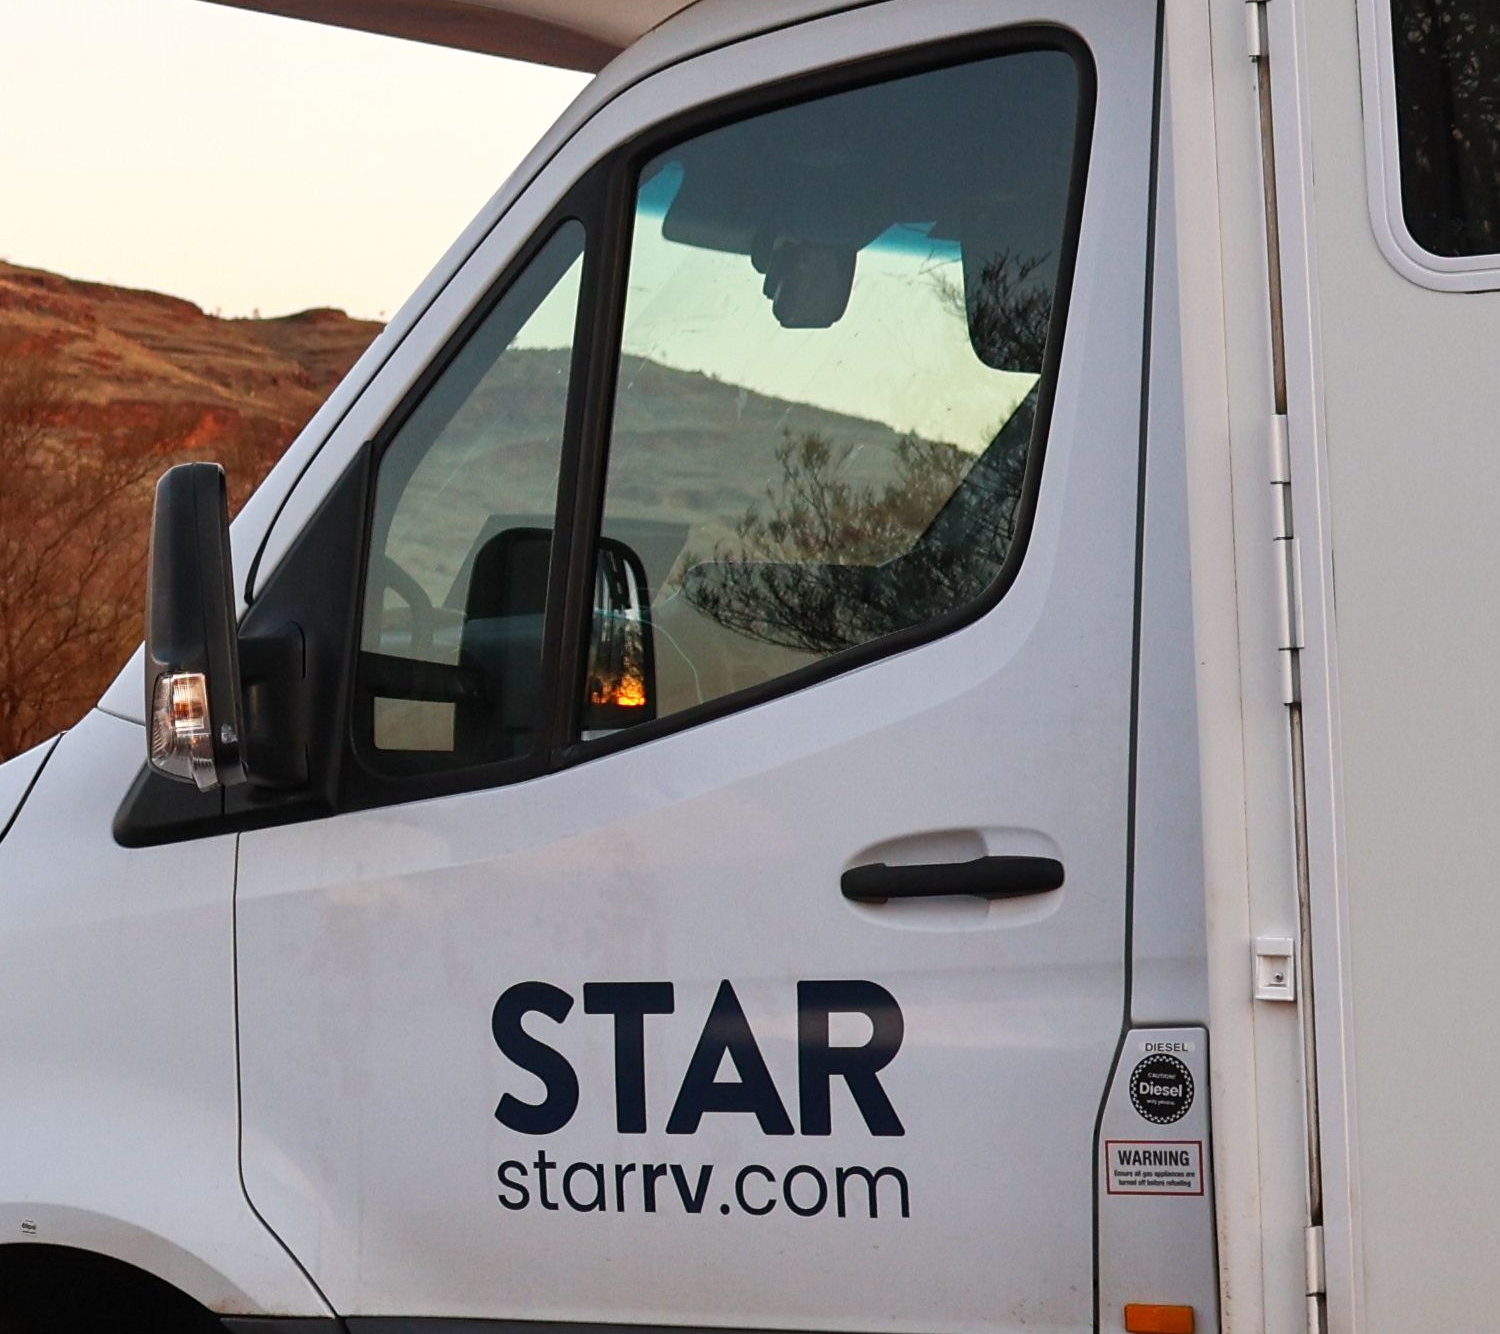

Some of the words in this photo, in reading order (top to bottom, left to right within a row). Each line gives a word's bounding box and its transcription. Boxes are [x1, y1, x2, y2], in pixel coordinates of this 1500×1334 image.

[1145, 1042, 1188, 1052] DIESEL
[492, 979, 905, 1136] STAR
[1139, 1081, 1183, 1097] Diesel
[1118, 1150, 1190, 1166] WARNING
[497, 1150, 910, 1218] starrv.com
